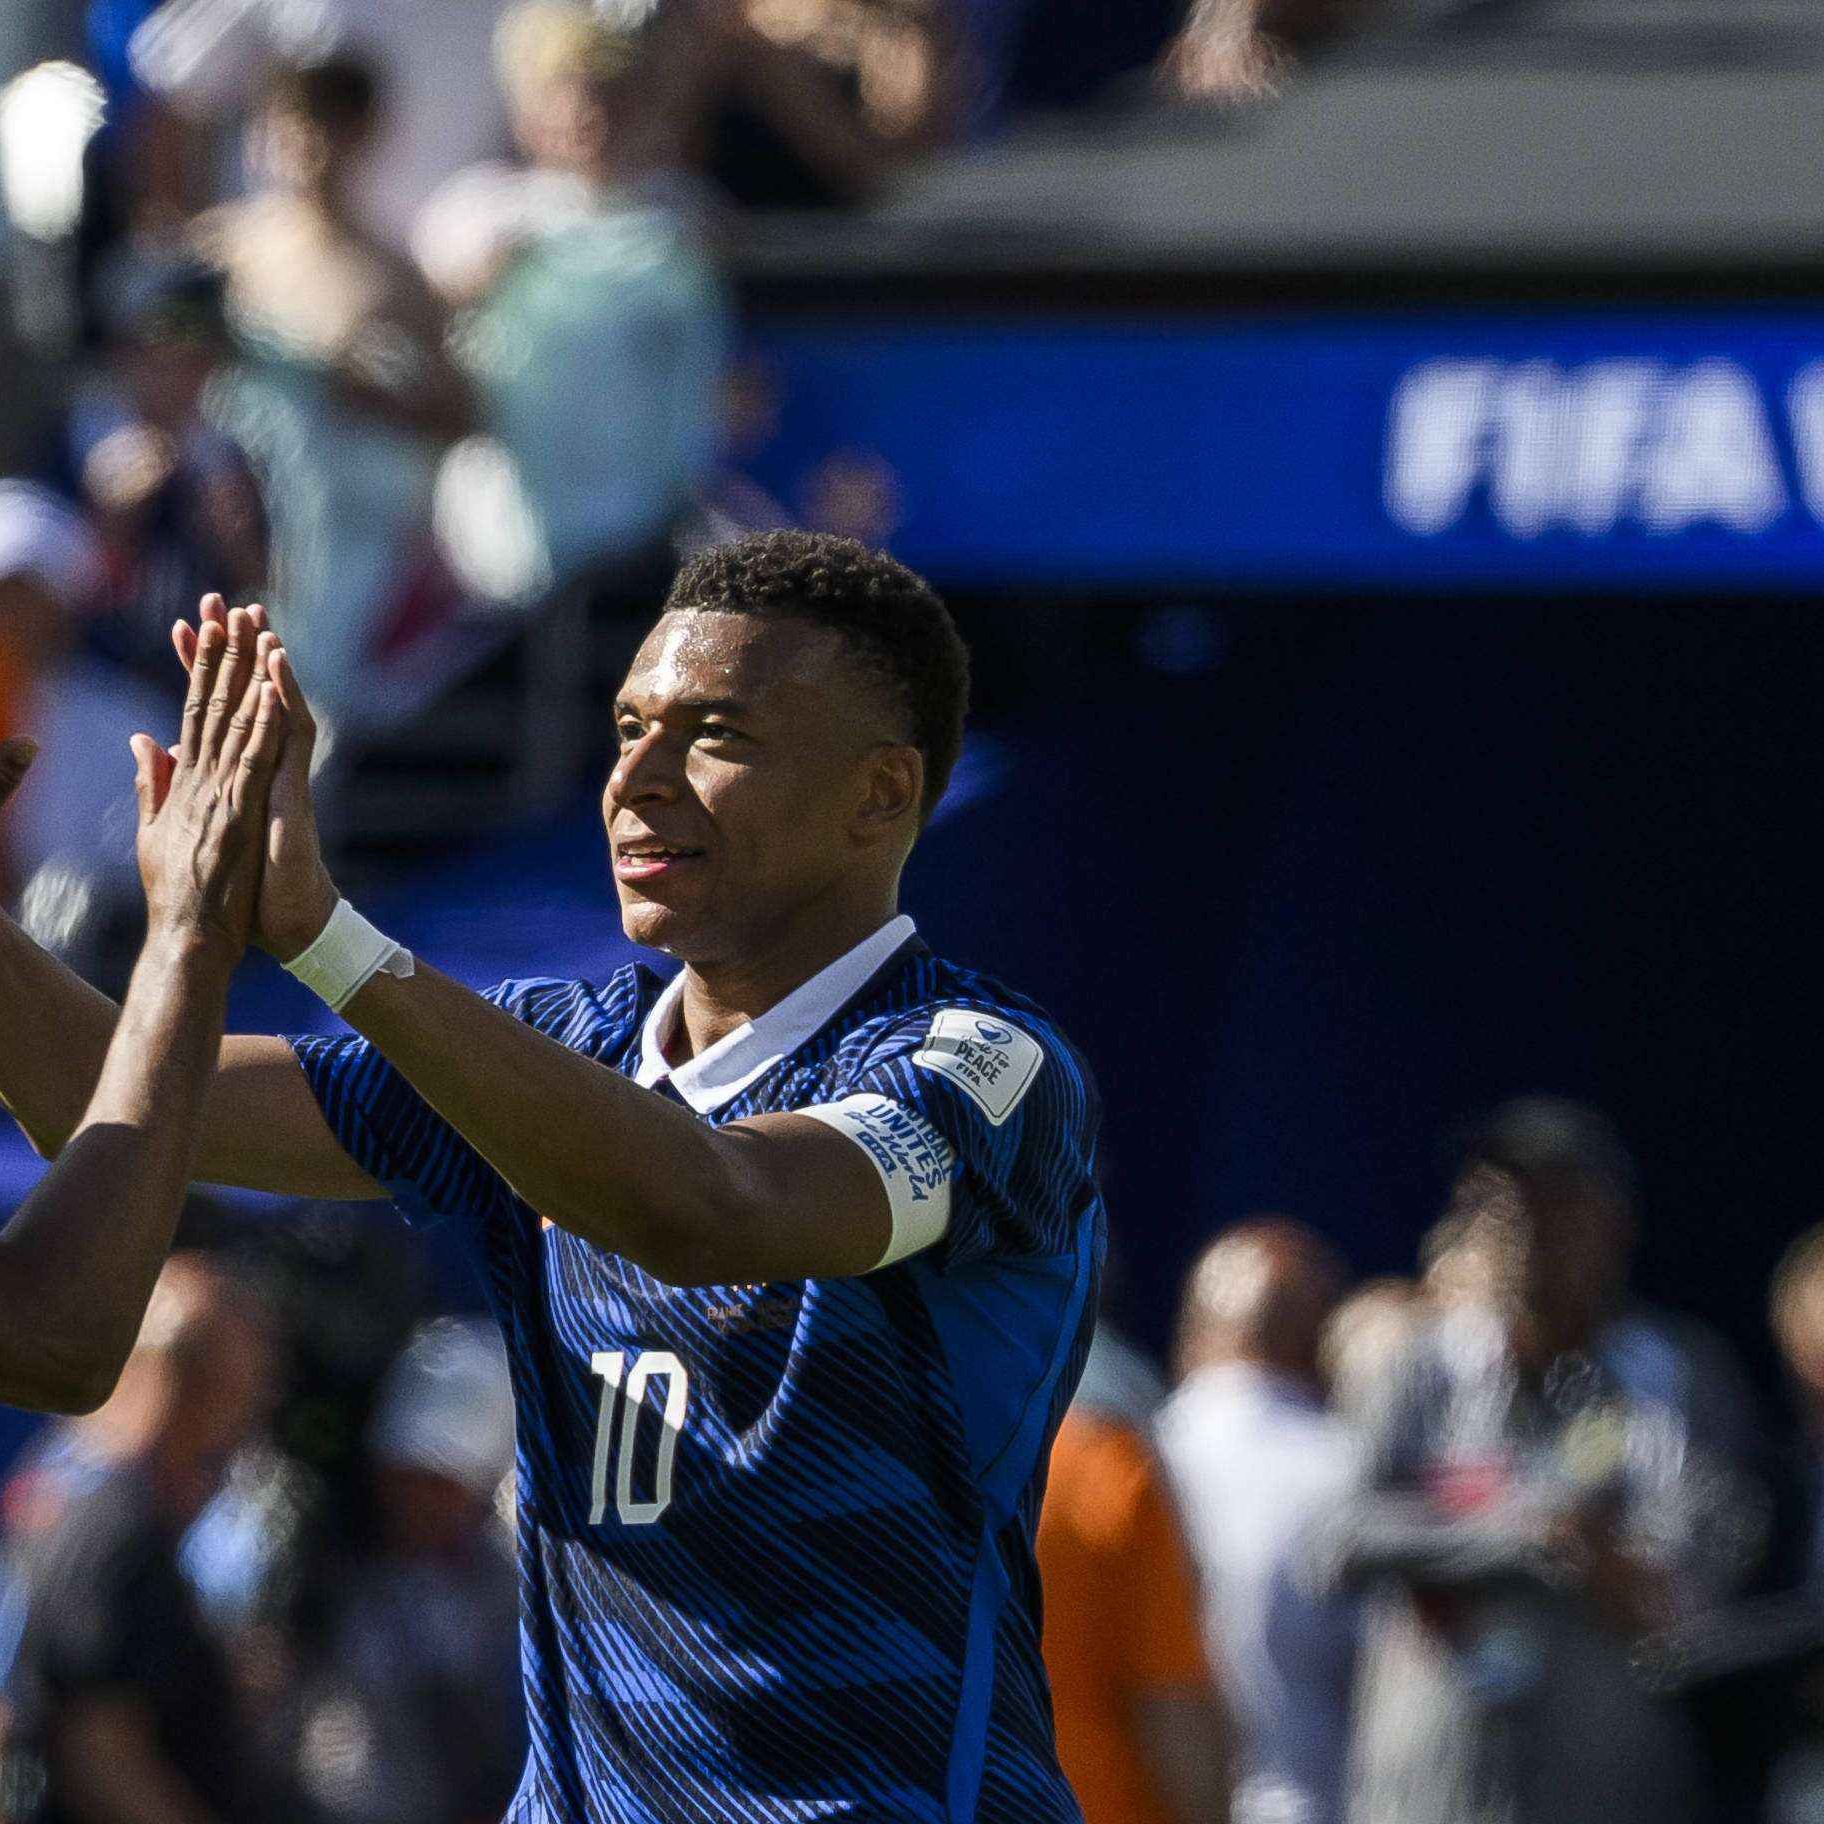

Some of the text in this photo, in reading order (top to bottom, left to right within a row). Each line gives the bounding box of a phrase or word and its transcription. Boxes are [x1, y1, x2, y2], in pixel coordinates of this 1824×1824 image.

[1383, 354, 1788, 538] FIFA
[954, 1040, 1003, 1086] PEACE
[956, 1062, 983, 1088] FIFA
[866, 1103, 943, 1190] UNITES
[879, 1133, 929, 1202] World
[588, 1352, 688, 1525] 10
